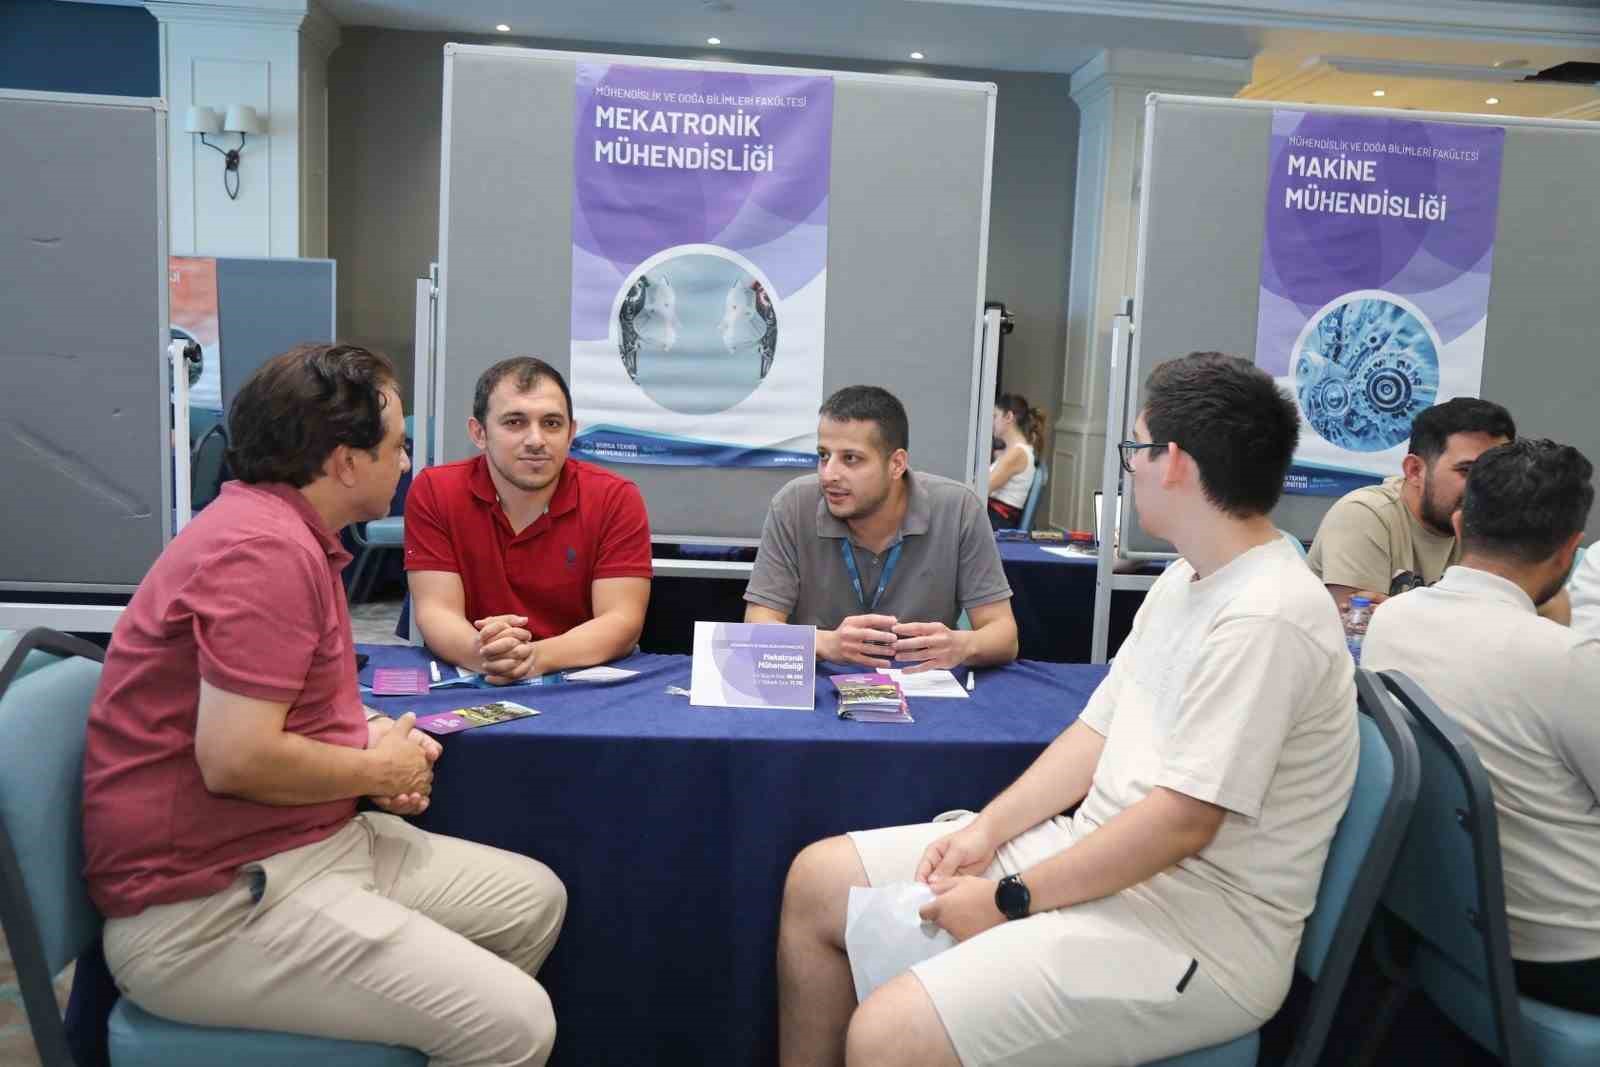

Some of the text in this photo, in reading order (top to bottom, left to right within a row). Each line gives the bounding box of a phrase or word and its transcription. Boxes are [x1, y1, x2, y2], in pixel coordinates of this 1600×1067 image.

[595, 86, 662, 102] MÜHENDİSLİK
[663, 92, 676, 103] VE
[706, 93, 753, 106] BİLİMLERİ
[754, 95, 807, 108] FAKÜLTESİ
[594, 104, 761, 137] MEKATRONİK
[594, 136, 775, 172] MÜHENDİSLİĞİ
[1288, 135, 1348, 151] MÜHENDİSLİK
[1350, 141, 1361, 152] VE
[1388, 143, 1432, 157] BİLİMLERİ
[1287, 153, 1377, 182] MAKİNE
[1284, 183, 1448, 222] MÜHENDİSLİĞİ
